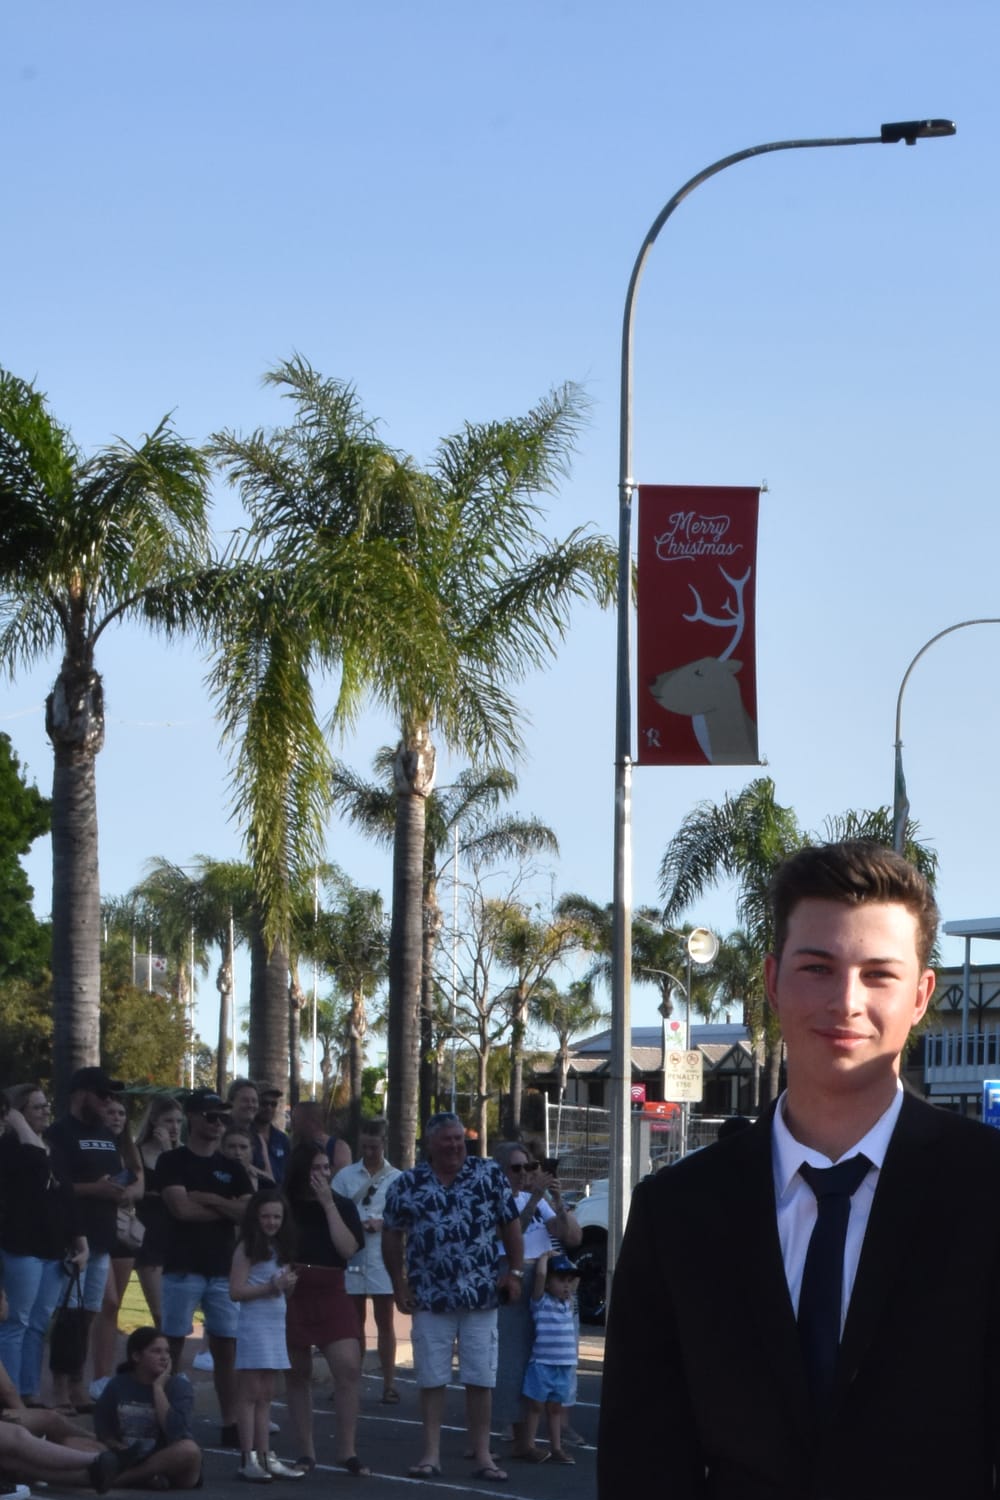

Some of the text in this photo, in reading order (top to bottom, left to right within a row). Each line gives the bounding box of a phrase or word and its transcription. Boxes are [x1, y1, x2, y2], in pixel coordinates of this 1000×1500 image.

[668, 511, 730, 542] Merry
[653, 532, 743, 562] Christmas
[667, 1073, 700, 1081] PENALTY
